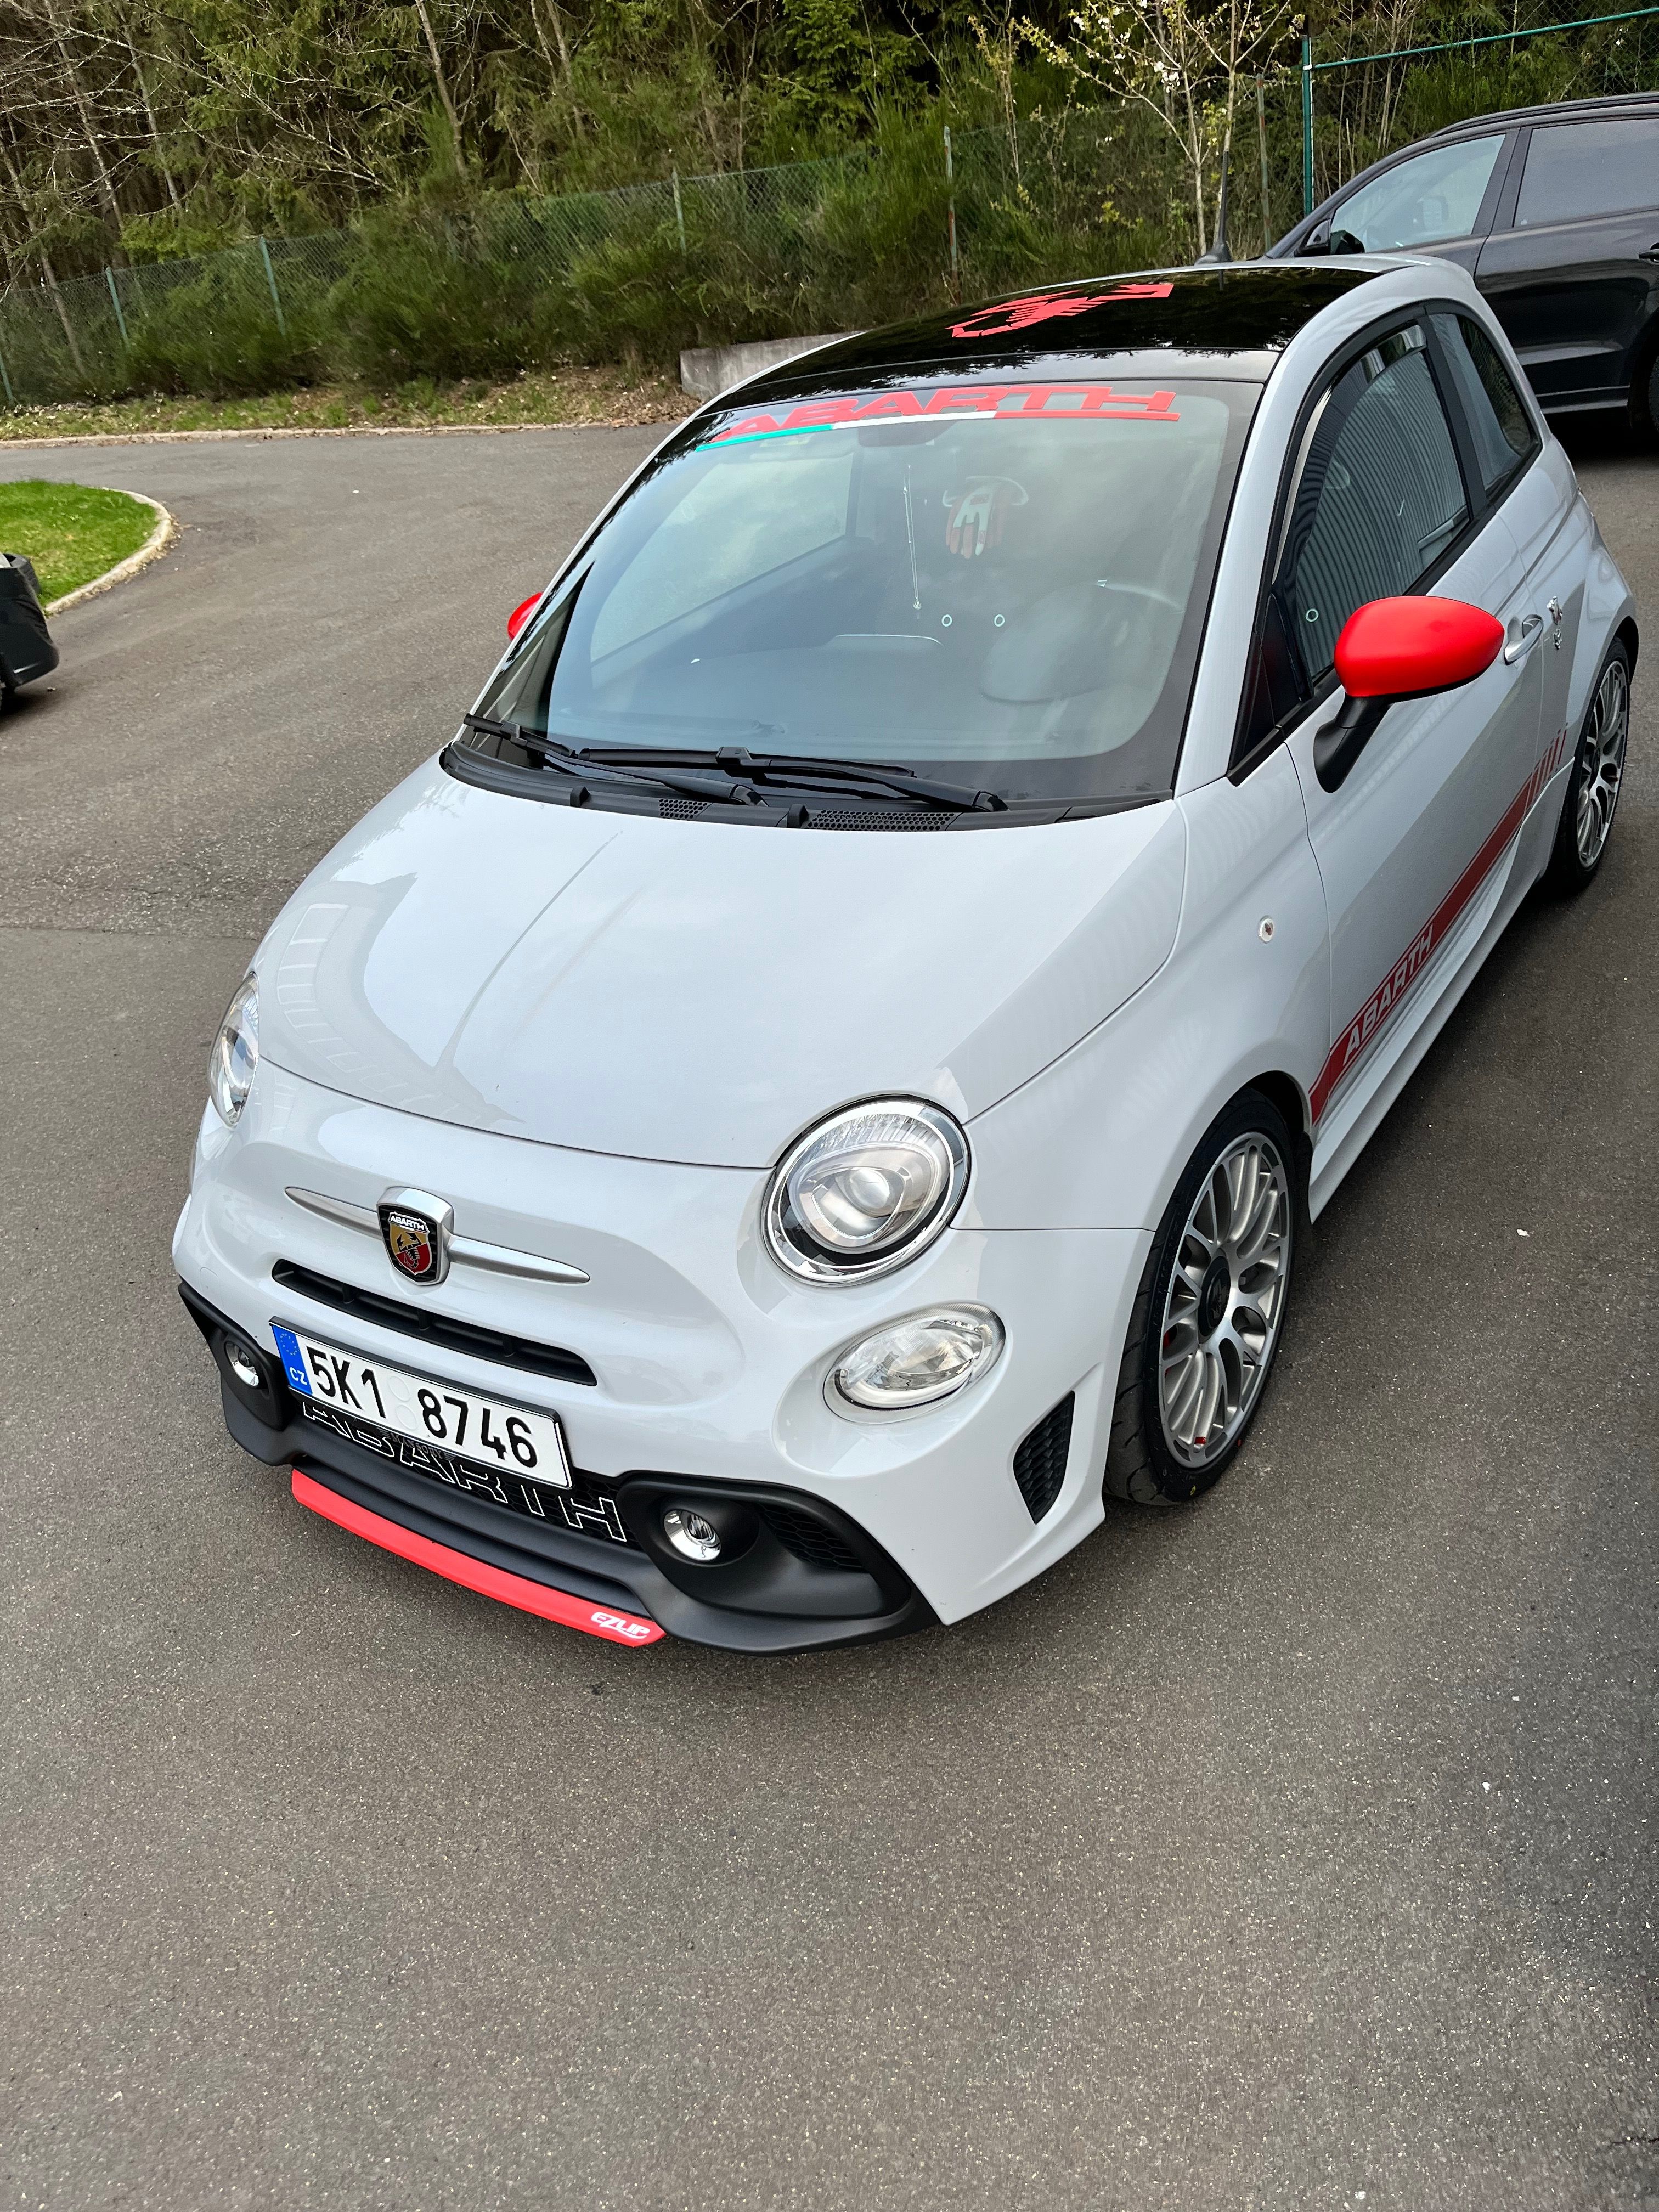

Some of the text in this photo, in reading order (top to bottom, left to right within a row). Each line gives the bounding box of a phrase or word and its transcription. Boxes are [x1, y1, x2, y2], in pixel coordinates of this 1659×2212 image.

[709, 386, 1177, 443] ABARTH
[1343, 923, 1433, 1066] ABARTH
[390, 1216, 424, 1230] ABARTH
[289, 1367, 307, 1385] CZ
[306, 1346, 538, 1468] 5K1 8746
[591, 1611, 650, 1639] EZLIP
